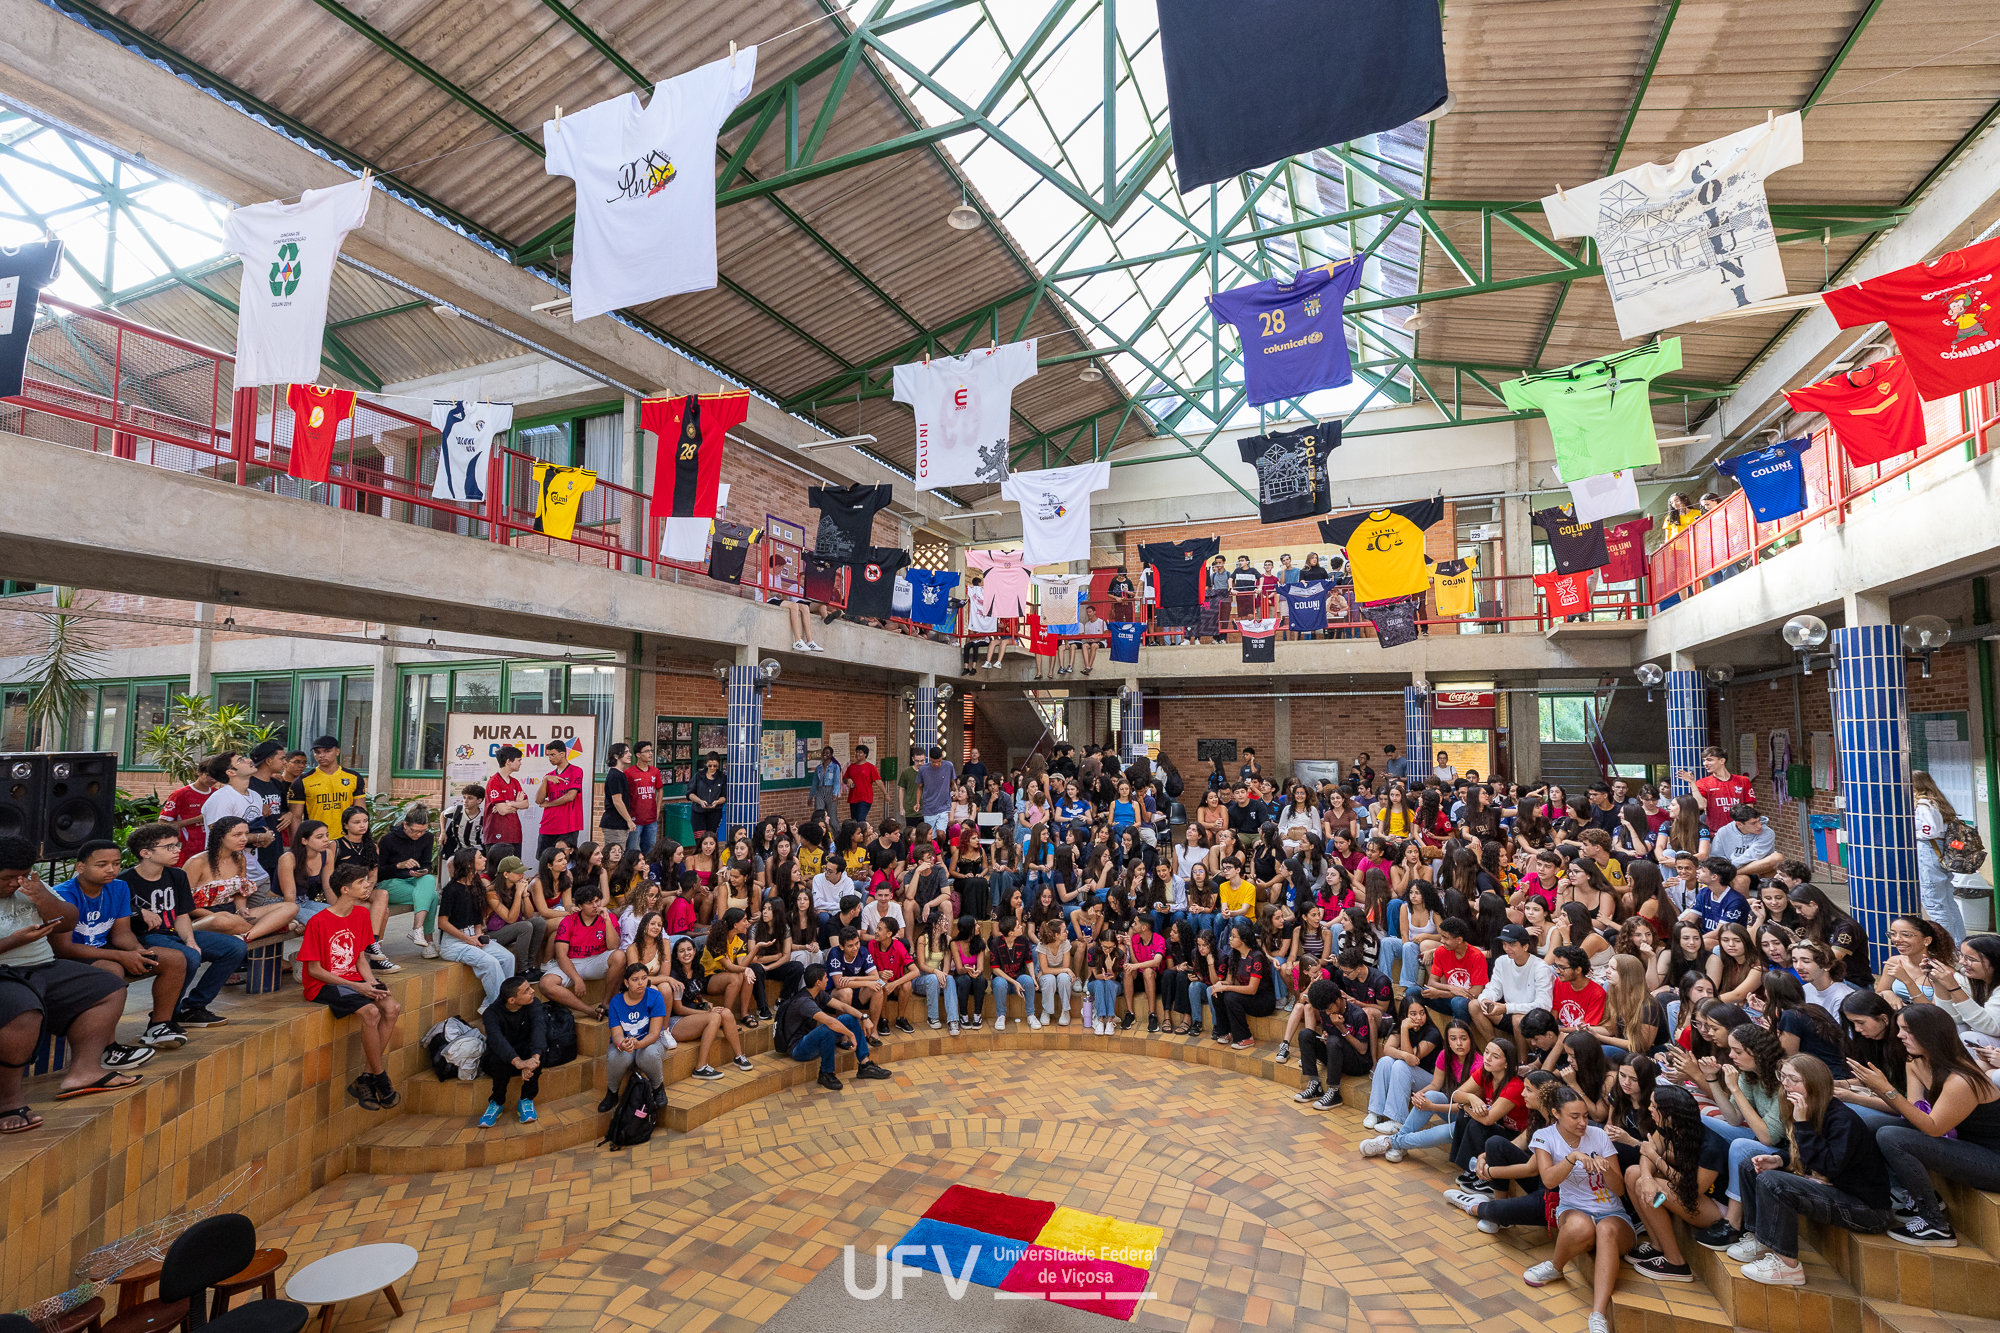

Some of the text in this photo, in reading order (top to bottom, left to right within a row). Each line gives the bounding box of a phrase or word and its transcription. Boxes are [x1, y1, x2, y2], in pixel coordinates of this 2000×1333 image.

[1691, 160, 1751, 308] COLUNI
[1258, 309, 1286, 337] 28
[1263, 335, 1308, 355] colunicef
[679, 442, 698, 461] 28
[919, 423, 928, 478] COLUNI
[1304, 435, 1317, 504] COLUNI
[1751, 459, 1792, 478] COLUNI
[1559, 522, 1593, 536] COLUNI
[1049, 586, 1069, 595] COLUNI
[1294, 600, 1320, 610] COLUNI
[473, 725, 575, 740] MURAL DO
[316, 792, 348, 804] COLUNI
[322, 803, 341, 811] 23-25
[150, 886, 176, 914] CO
[86, 910, 100, 922] 60
[628, 1011, 640, 1020] 60
